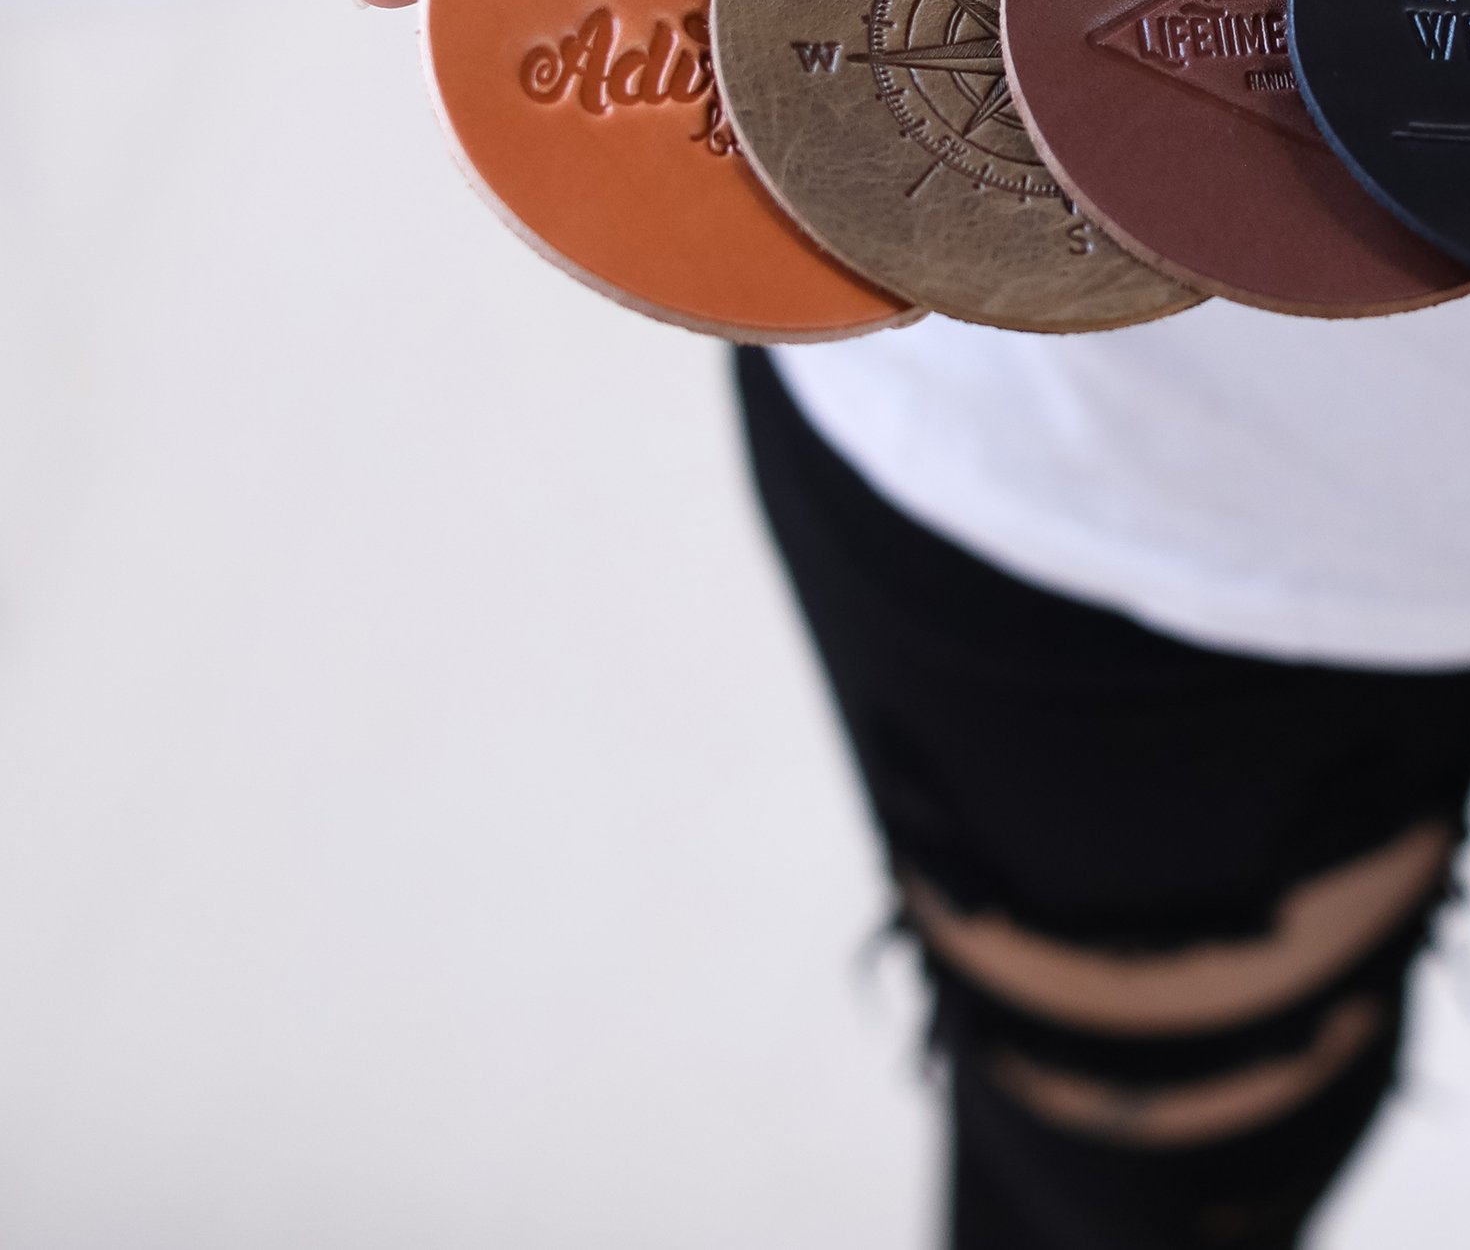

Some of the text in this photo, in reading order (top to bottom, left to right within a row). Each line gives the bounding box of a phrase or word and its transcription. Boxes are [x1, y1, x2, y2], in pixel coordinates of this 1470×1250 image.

[1137, 2, 1289, 68] LIFETIME
[792, 41, 843, 74] W
[1066, 222, 1095, 255] S
